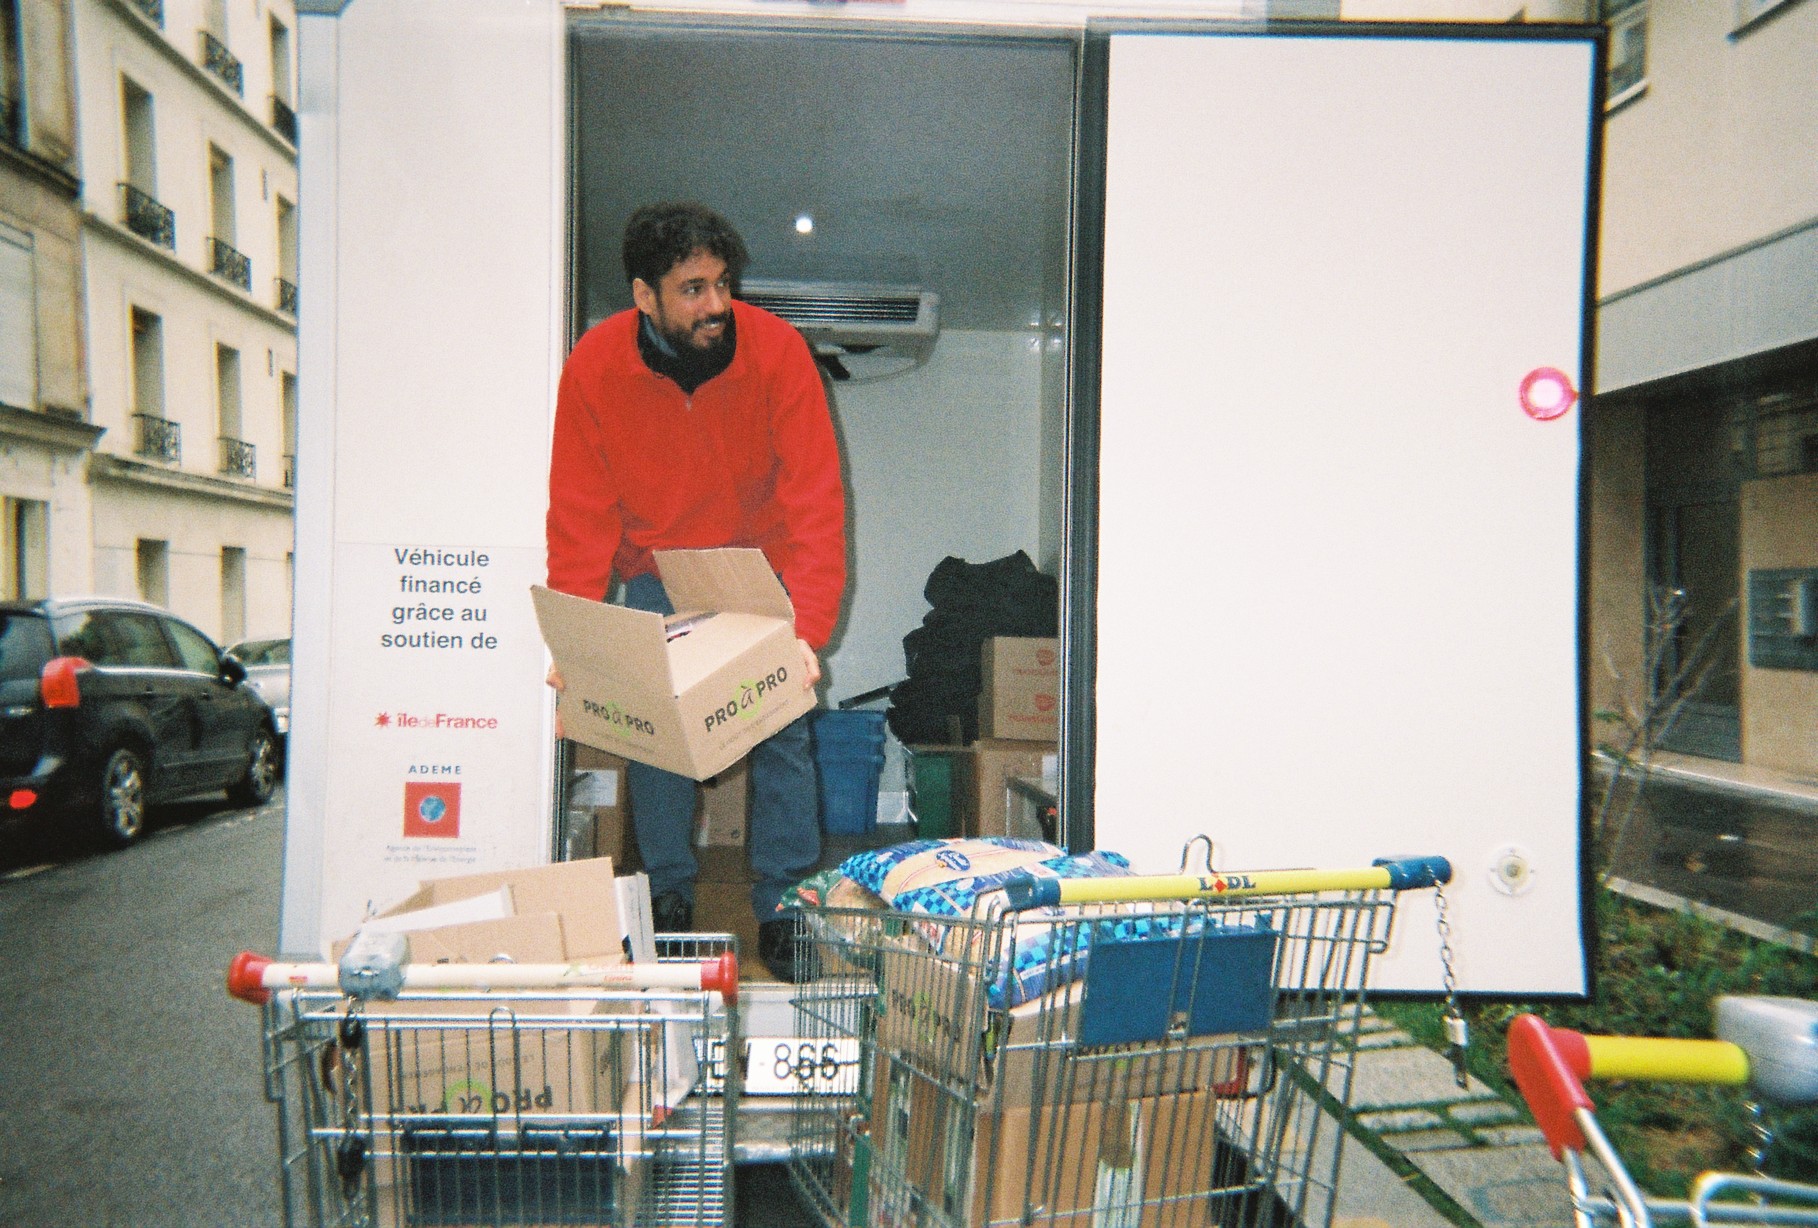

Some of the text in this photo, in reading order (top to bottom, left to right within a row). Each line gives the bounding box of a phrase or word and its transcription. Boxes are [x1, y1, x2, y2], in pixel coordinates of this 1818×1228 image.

[394, 548, 489, 567] Véhicule
[400, 575, 482, 594] financé
[392, 602, 487, 625] grâce au
[381, 631, 498, 649] soutien de
[704, 700, 738, 732] PRO
[756, 666, 787, 698] PRO
[583, 699, 610, 720] PRO
[625, 714, 654, 735] PRO
[408, 765, 462, 775] ADEME
